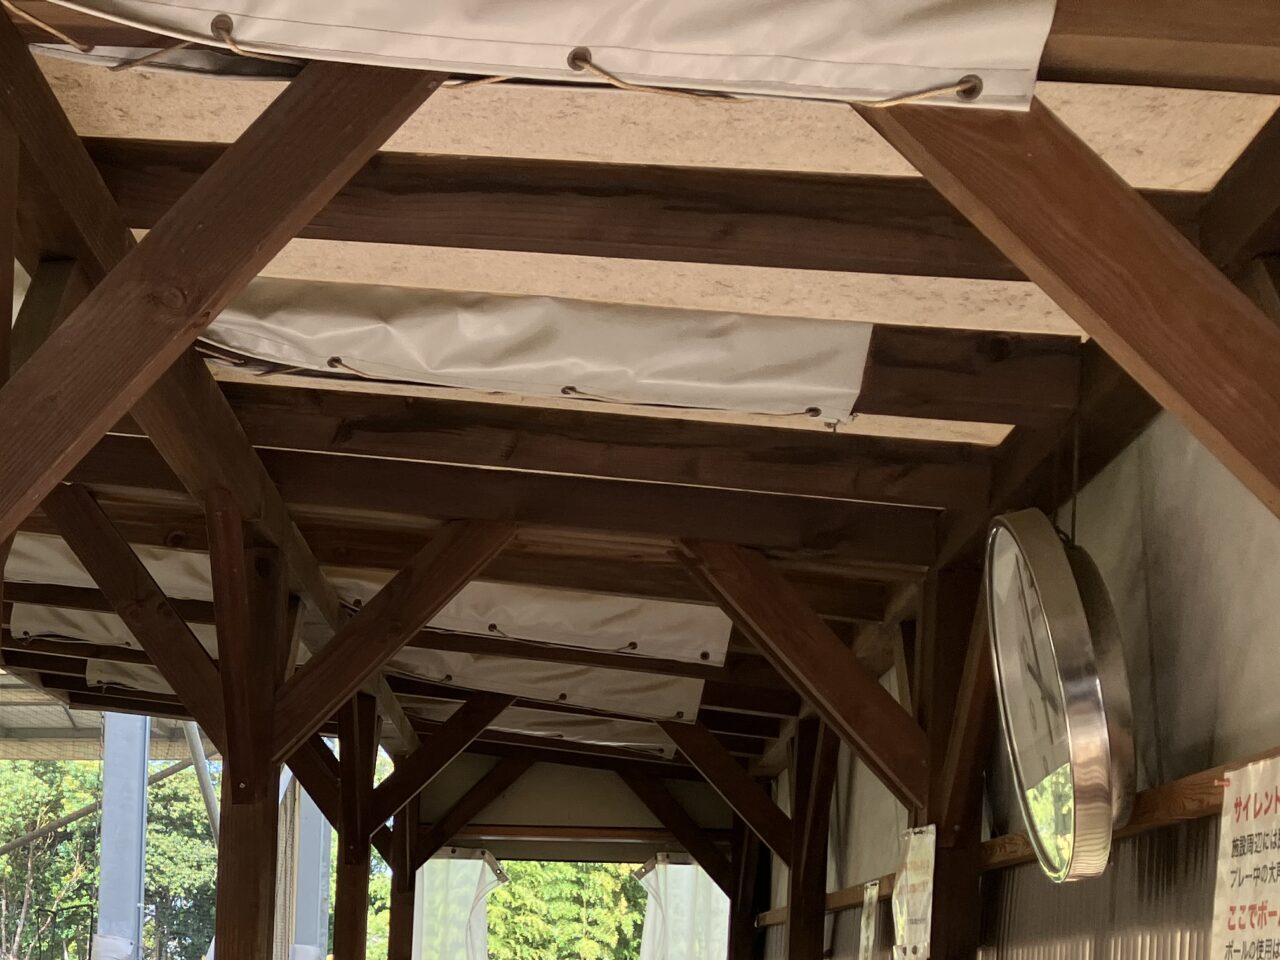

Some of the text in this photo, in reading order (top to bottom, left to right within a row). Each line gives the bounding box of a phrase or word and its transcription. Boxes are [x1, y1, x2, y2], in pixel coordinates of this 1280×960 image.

[1227, 900, 1280, 931] ここでボー
